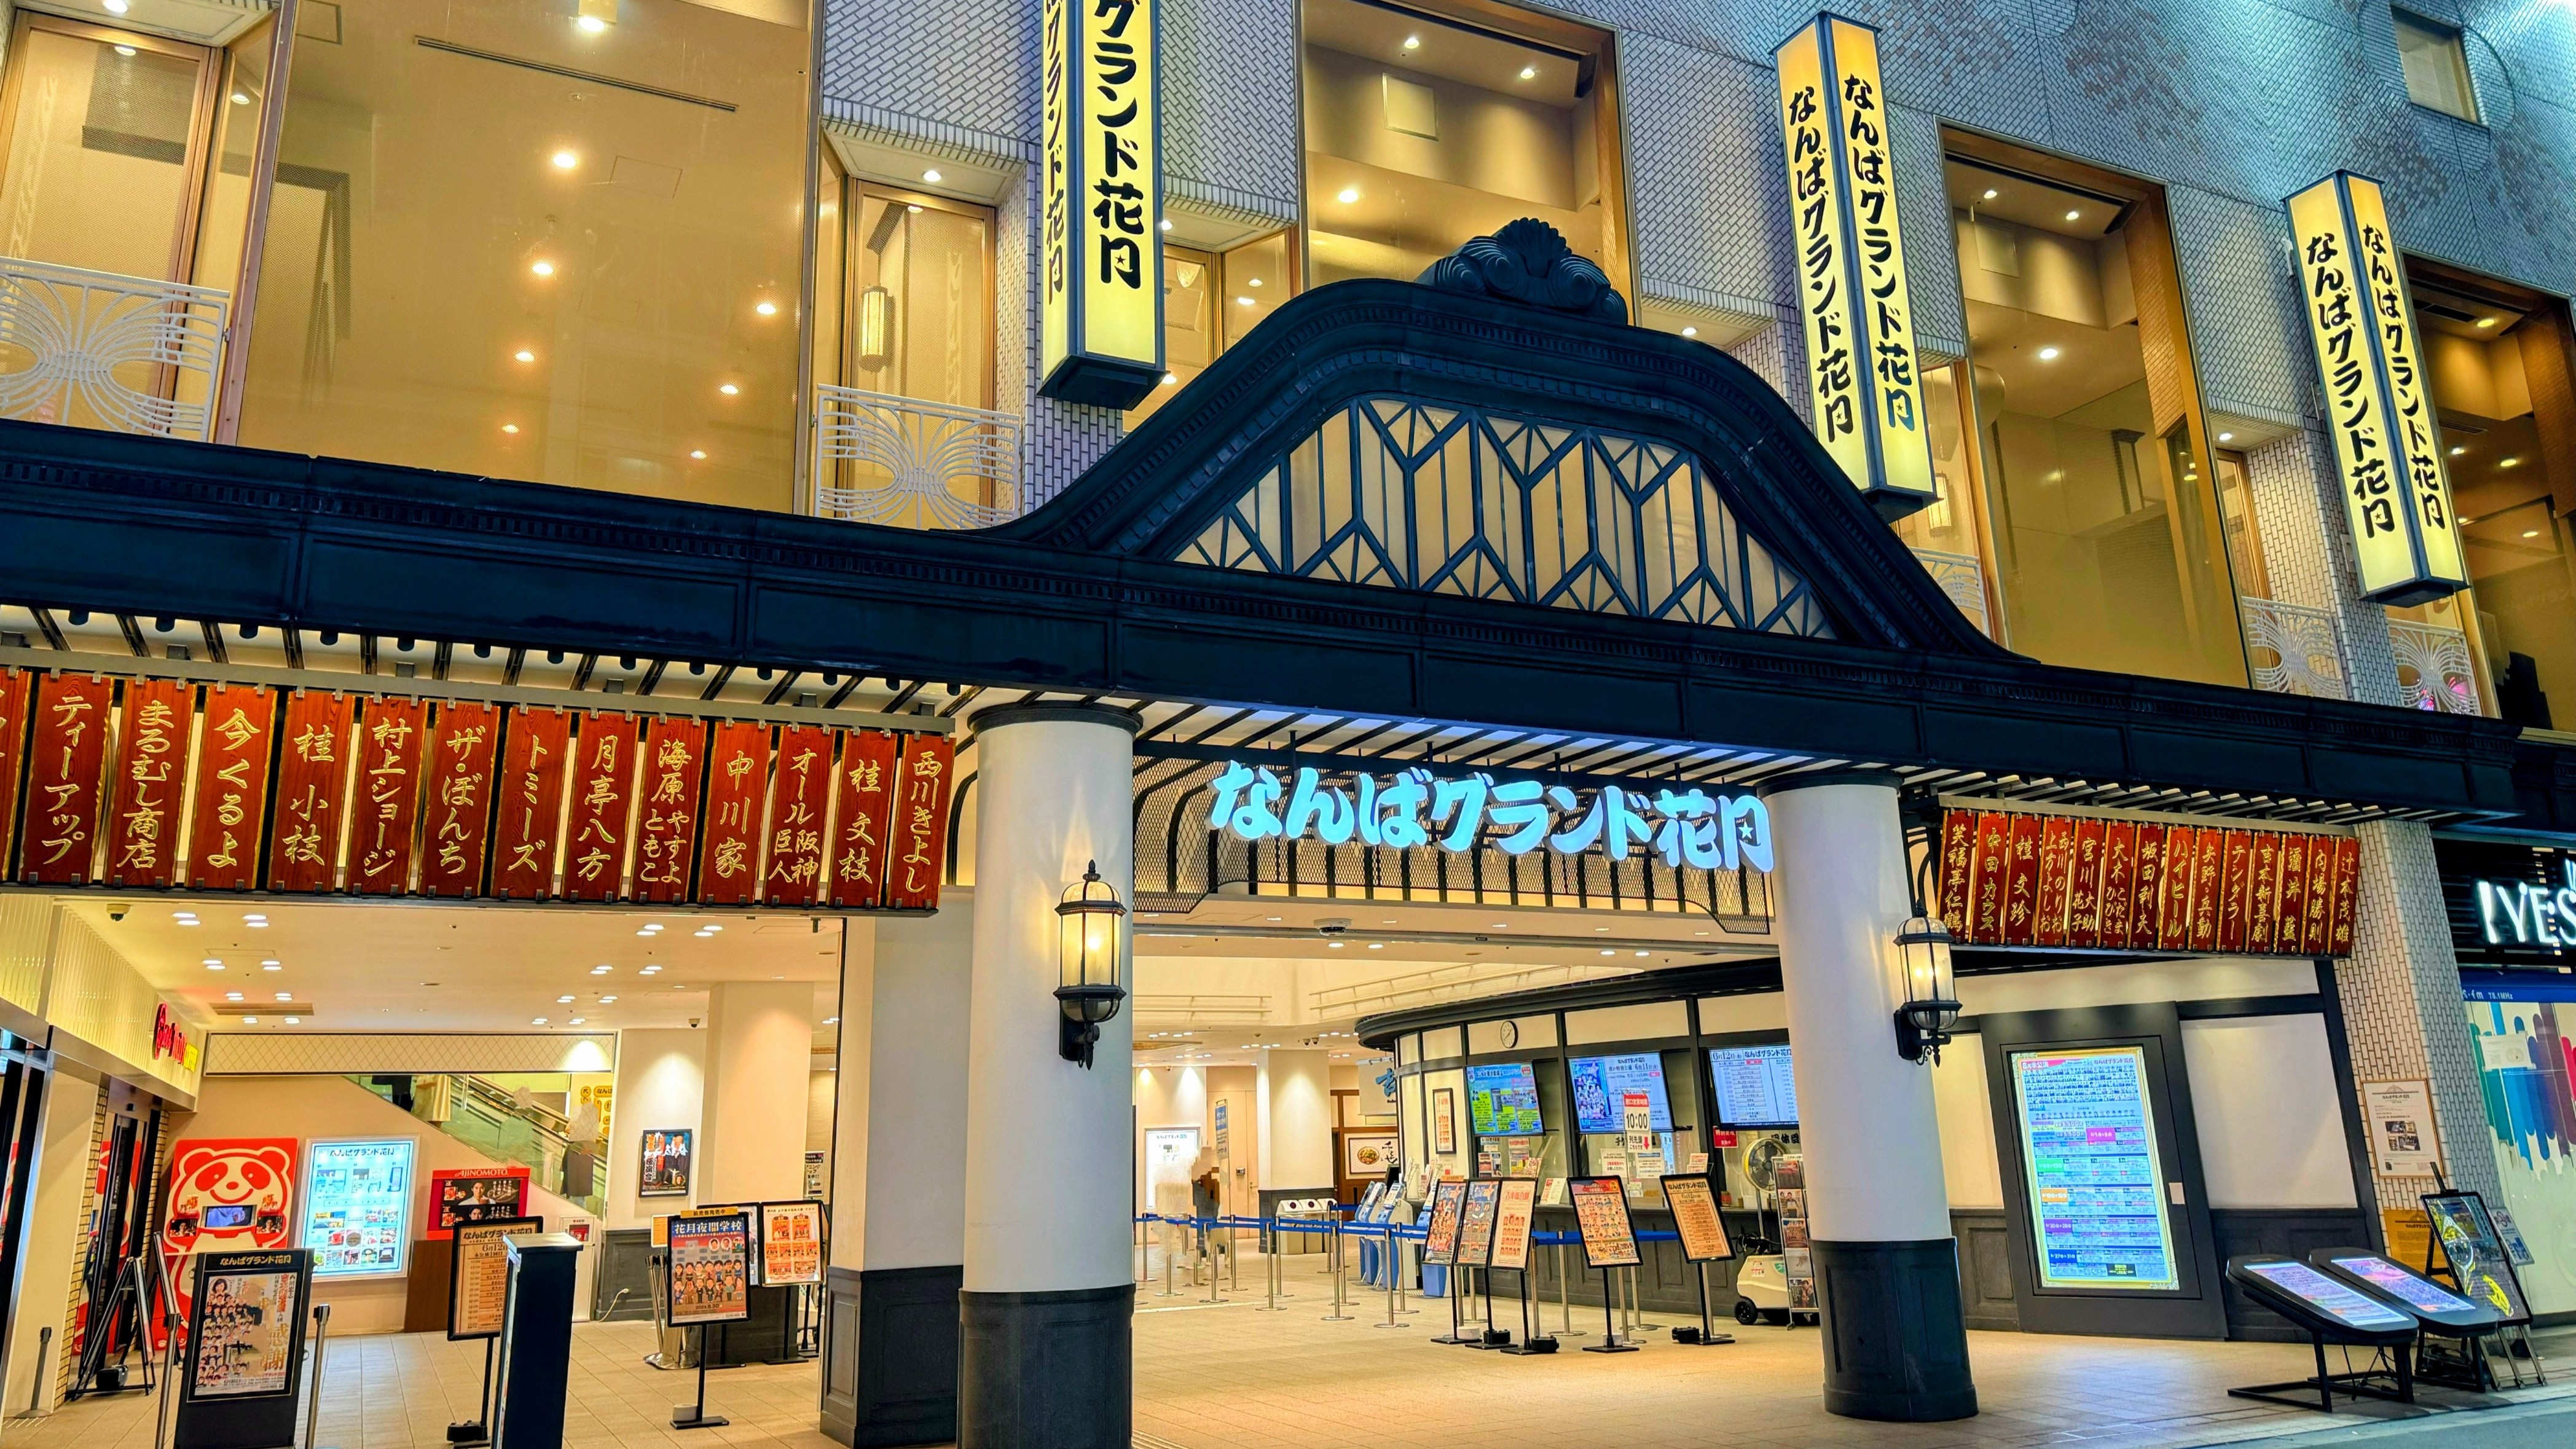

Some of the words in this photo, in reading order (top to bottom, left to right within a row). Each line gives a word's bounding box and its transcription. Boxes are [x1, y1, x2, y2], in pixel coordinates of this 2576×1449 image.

[1045, 0, 1064, 305] グランド花月
[1789, 85, 1853, 444] なんばグランド花月
[1844, 73, 1915, 433] なんばグランド花月
[2306, 232, 2395, 540] なんばグランド花月
[2362, 222, 2444, 530] なんばグランド花月
[41, 696, 92, 865] ティーアップ
[117, 700, 171, 869] まるむし商店
[206, 707, 261, 868] 今くるよ
[363, 717, 412, 878] 村上ショージ
[438, 725, 485, 874] ザ・ぼんち
[508, 735, 548, 873] トミーズ
[578, 735, 619, 881] 月亭八方
[715, 750, 755, 879] 中川家
[903, 750, 943, 893] 西川きよし
[1207, 759, 1775, 873] なんばグランド花月
[1979, 827, 2001, 931] 中田カウス
[2167, 839, 2188, 938] ハイヒール
[2228, 845, 2246, 940] テンダラー
[2252, 844, 2274, 943] 吉本新喜劇
[2309, 849, 2327, 944] 内場勝則
[2336, 852, 2355, 944] 辻本茂雄
[455, 1169, 509, 1178] AJINOMOTO
[1382, 1141, 1398, 1164] 千とせ
[1626, 1113, 1647, 1129] 10:00
[1668, 1181, 1707, 1190] なんばグランド花月
[220, 1255, 291, 1266] なんばグランド花月
[674, 1220, 742, 1235] 花月夜間学校
